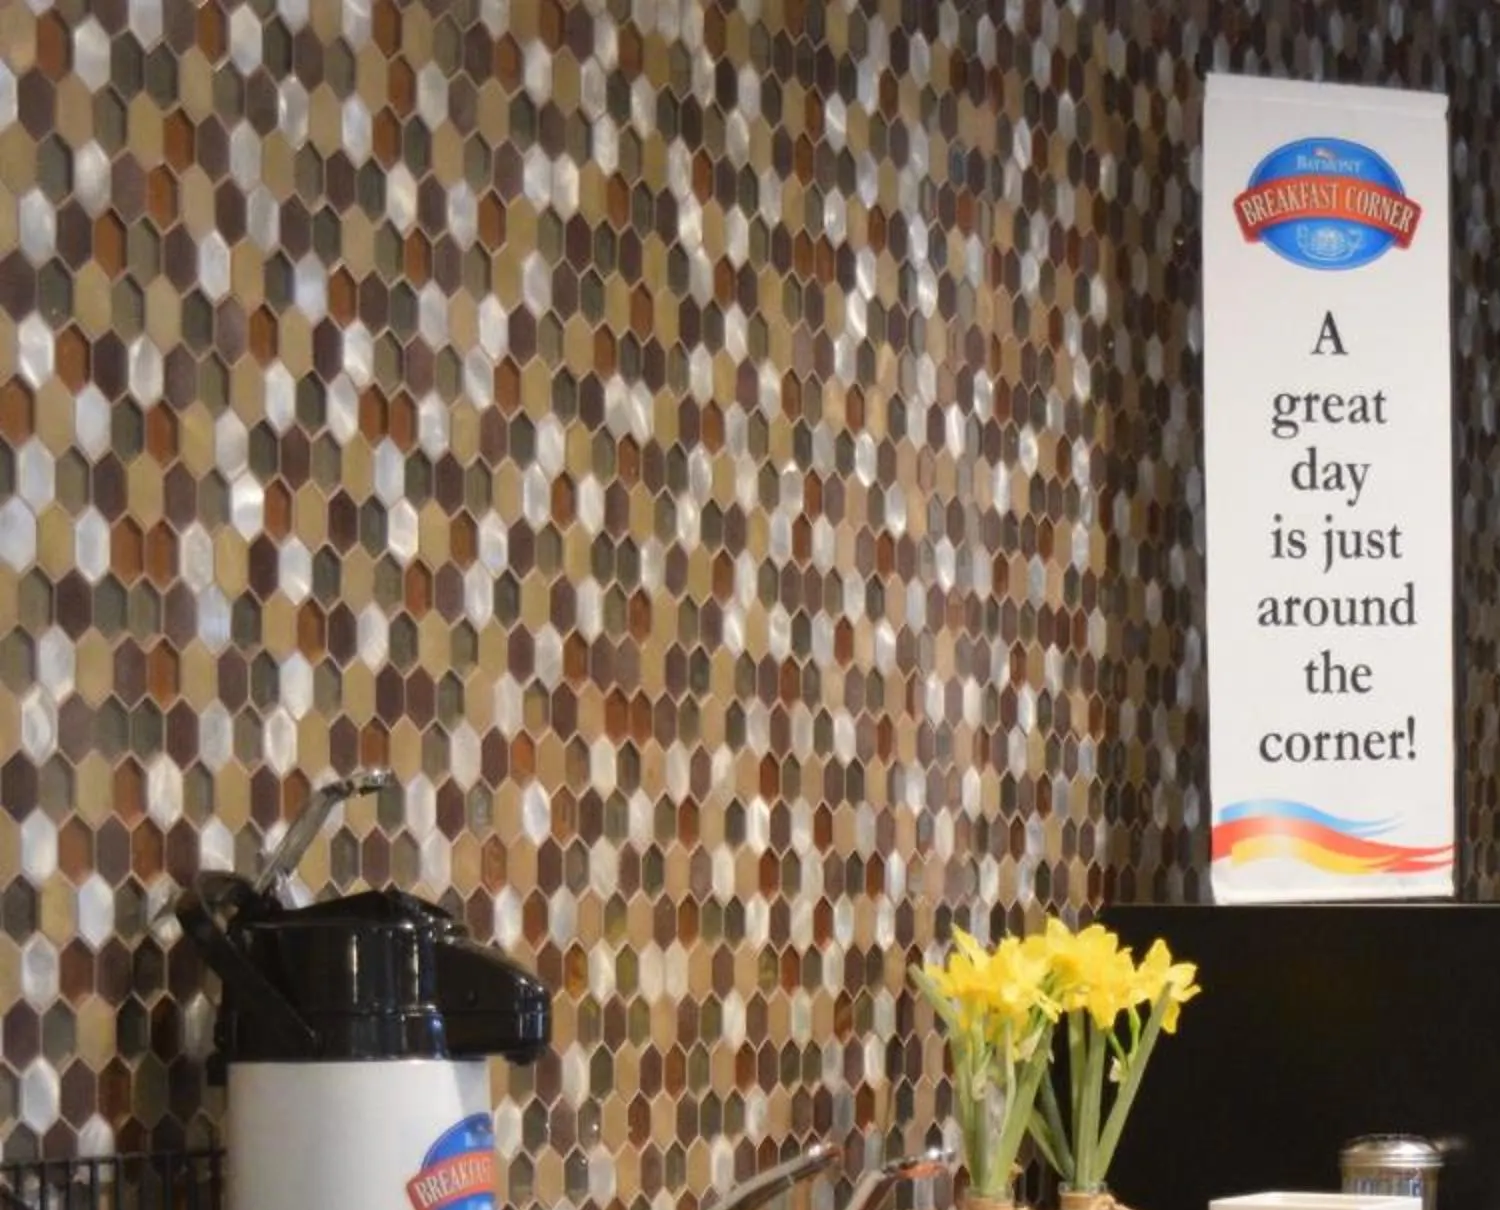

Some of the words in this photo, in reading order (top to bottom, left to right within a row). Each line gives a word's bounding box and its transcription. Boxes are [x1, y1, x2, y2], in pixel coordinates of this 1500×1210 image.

[1241, 182, 1339, 226] BREAKFAST
[1345, 185, 1415, 234] CORNER
[1310, 310, 1349, 356] A
[1271, 389, 1387, 439] great
[1290, 446, 1371, 507] day
[1271, 513, 1307, 560] is
[1323, 513, 1403, 574] just
[1257, 581, 1417, 626] around
[1303, 649, 1373, 694] the
[1258, 715, 1416, 763] corner!
